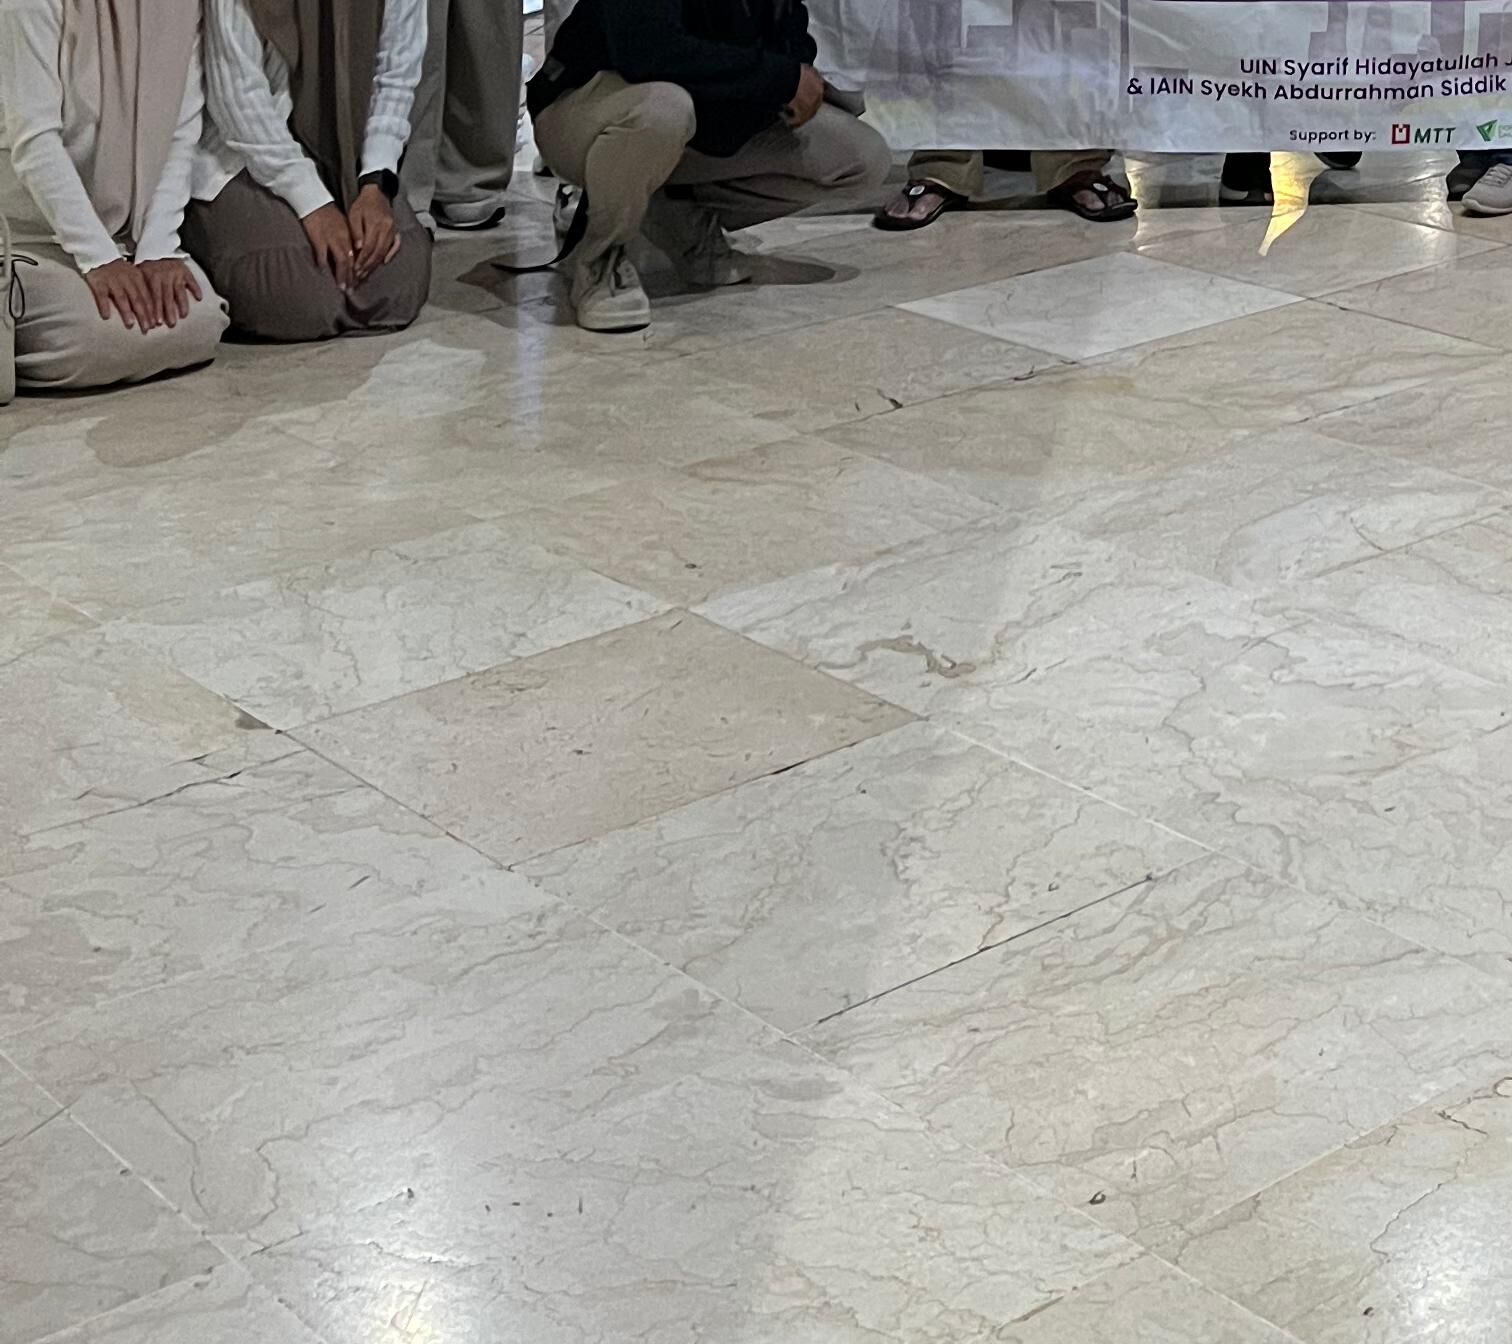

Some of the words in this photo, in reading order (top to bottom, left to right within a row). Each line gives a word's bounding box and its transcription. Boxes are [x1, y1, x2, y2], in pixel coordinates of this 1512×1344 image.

[1239, 58, 1277, 76] UIN
[1283, 56, 1349, 81] Syarif
[1355, 52, 1498, 81] Hidayatullah
[1126, 78, 1144, 95] &
[1150, 77, 1194, 95] IAIN
[1200, 79, 1268, 101] Syekh
[1273, 81, 1434, 101] Abdurrahman
[1440, 75, 1507, 97] Siddik
[1289, 128, 1350, 144] Support
[1353, 128, 1377, 144] by:
[1413, 127, 1457, 144] MTT
